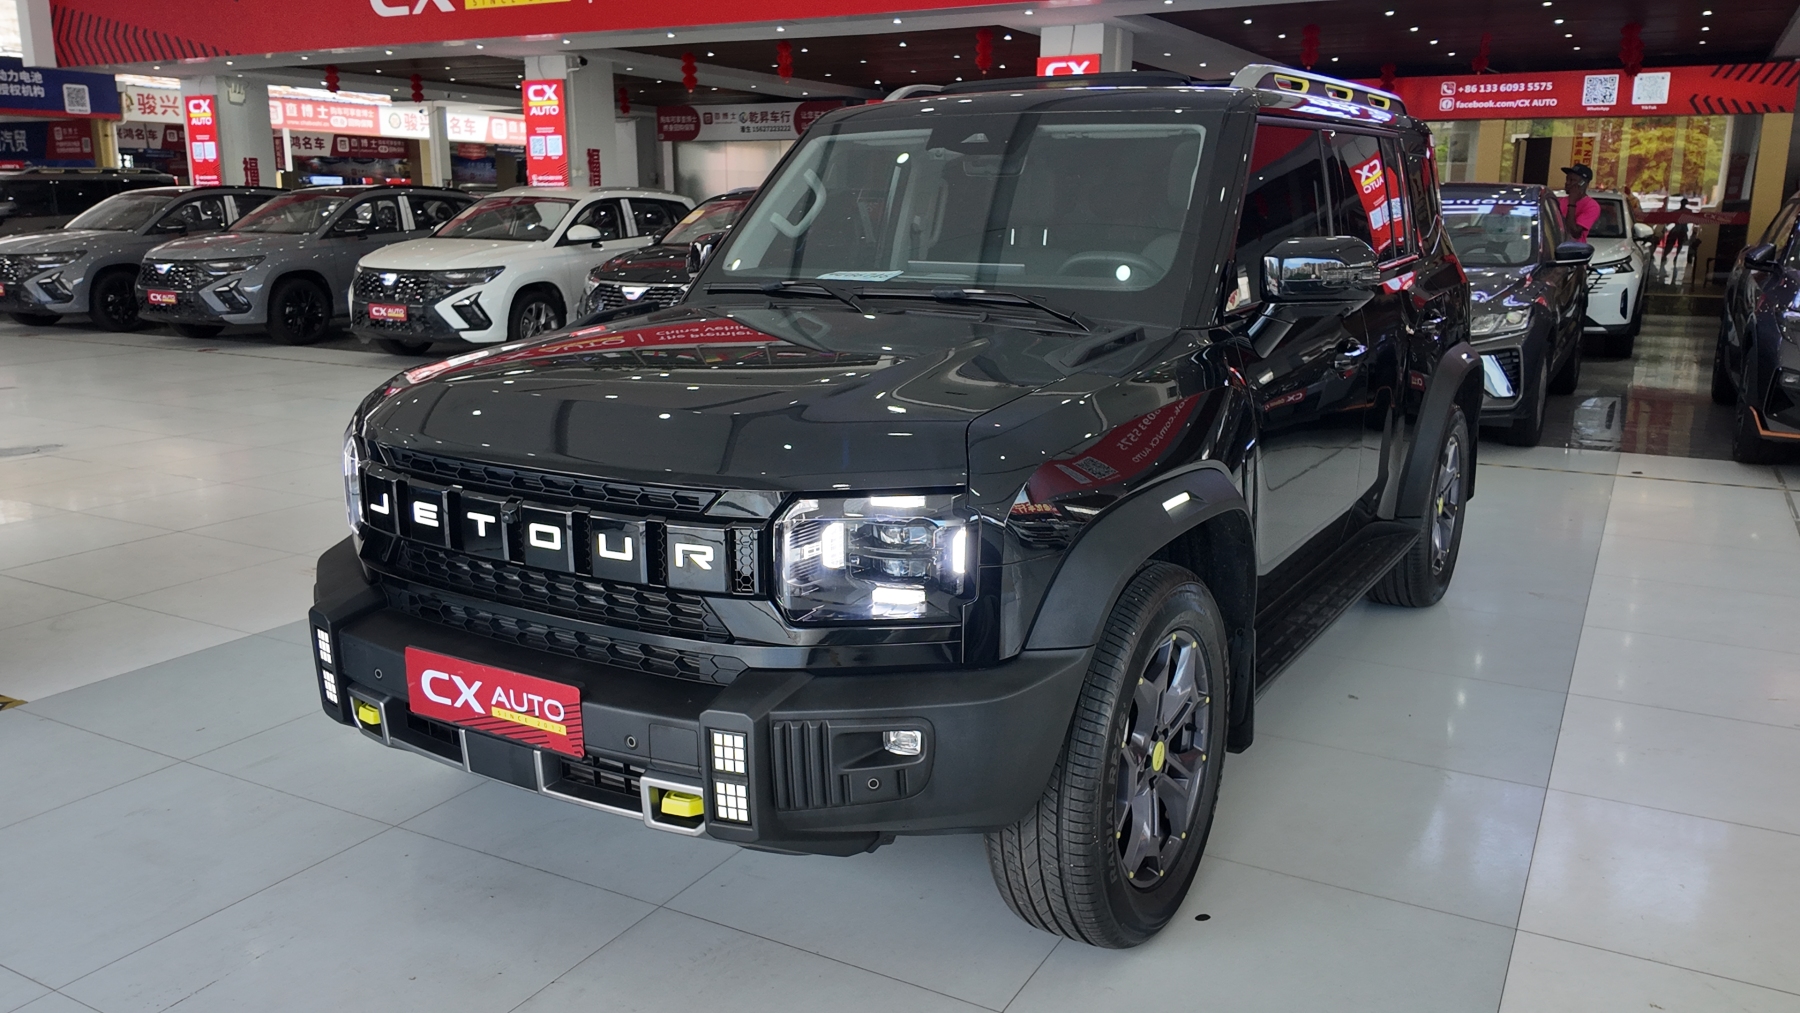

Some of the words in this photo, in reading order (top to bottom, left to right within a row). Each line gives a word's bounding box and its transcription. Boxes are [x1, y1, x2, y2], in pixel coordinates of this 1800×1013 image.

[527, 84, 558, 101] CX
[1457, 83, 1477, 93] +86
[1479, 83, 1498, 93] 133
[1500, 83, 1525, 93] 6093
[1527, 82, 1553, 92] 5575
[136, 93, 180, 117] 骏兴
[189, 99, 211, 113] CX
[530, 106, 559, 116] AUTO
[1456, 99, 1530, 109] facebook.com/CX
[1532, 98, 1557, 107] AUTO
[191, 117, 212, 125] AUTO
[450, 117, 476, 135] 名车
[0, 130, 28, 152] 汽贸
[150, 293, 161, 301] CX
[372, 306, 387, 316] CX
[370, 493, 714, 570] JETOUR
[421, 669, 486, 714] CX
[491, 686, 565, 722] AUTO
[497, 710, 529, 724] SINCE
[537, 721, 563, 732] 2012
[1103, 794, 1118, 884] RADIAL
